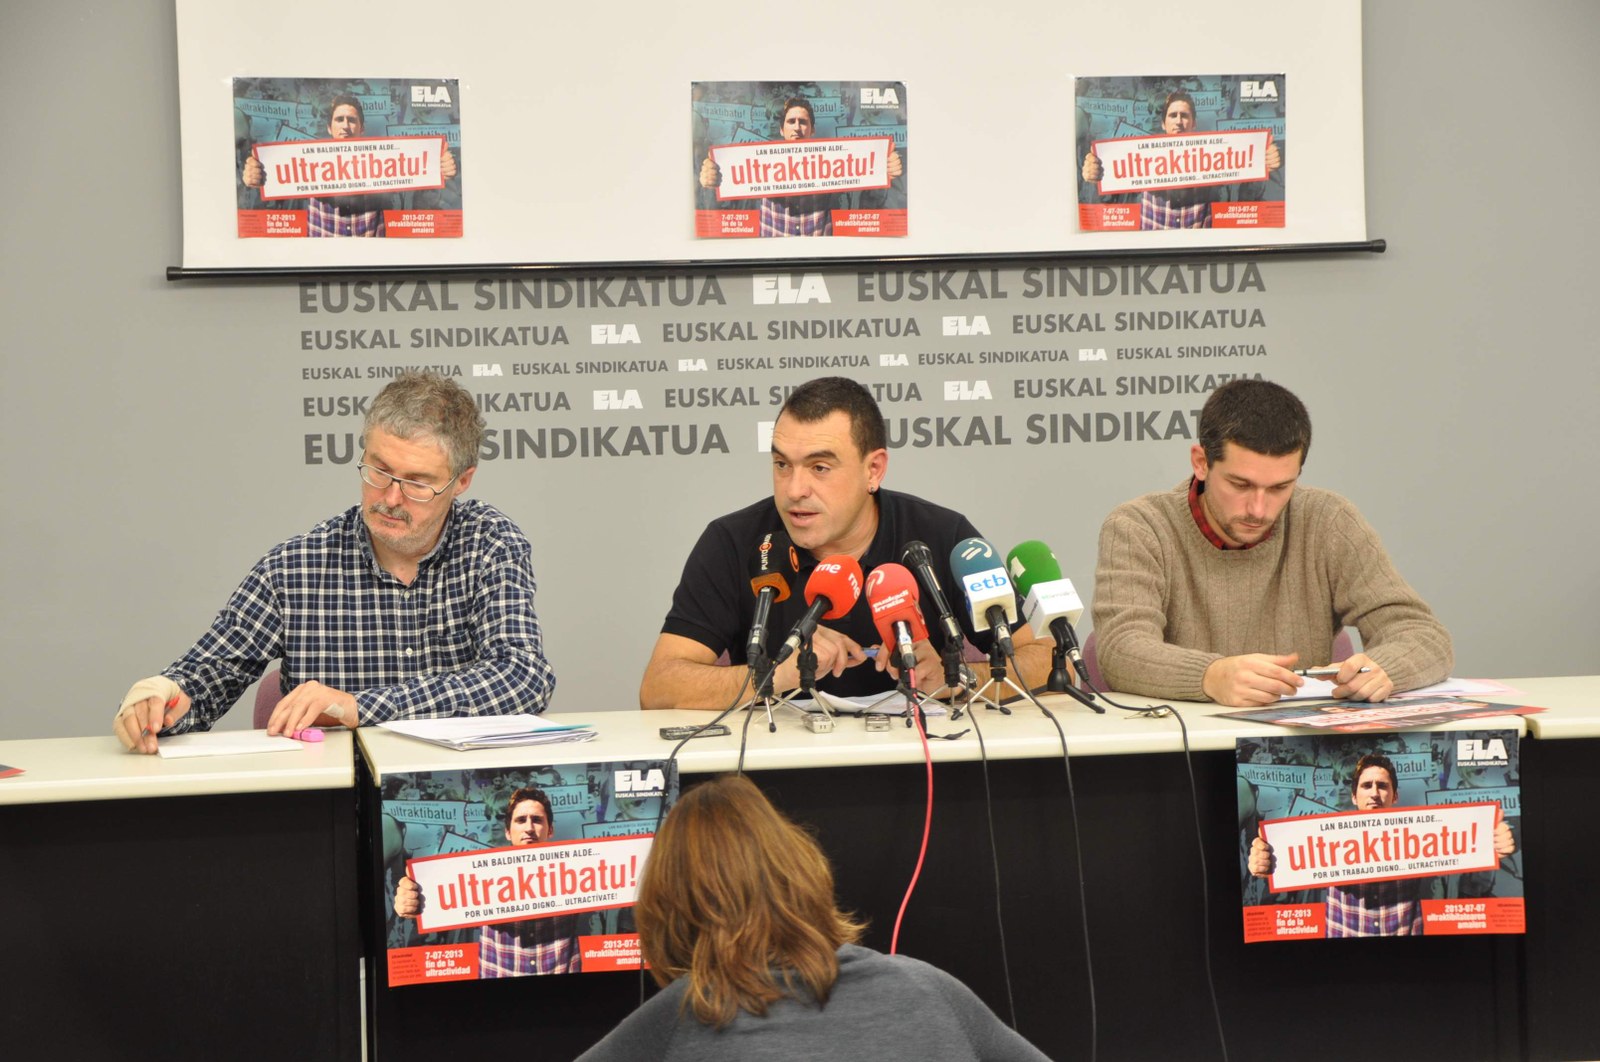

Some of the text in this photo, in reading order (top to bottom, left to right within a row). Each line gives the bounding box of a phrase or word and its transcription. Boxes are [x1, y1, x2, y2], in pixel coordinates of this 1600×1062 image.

[411, 85, 452, 103] ELA
[860, 87, 900, 105] ELA
[1240, 80, 1279, 98] ELA
[317, 145, 352, 154] BALDINTZA
[353, 144, 377, 152] DUINEN
[769, 146, 803, 155] BALDINTZA
[1151, 140, 1184, 149] BALDINTZA
[275, 150, 428, 185] ultraktibatu!
[730, 151, 876, 185] ultraktibatu!
[1112, 144, 1254, 179] ultraktibatu!
[321, 183, 347, 191] TRABAJO
[772, 183, 797, 191] TRABAJO
[299, 262, 1267, 314] EUSKAL SINDIKATUA ELA EUSKAL SINDIKATUA
[301, 308, 1267, 350] EUSKAL SINDIKATUA ELA EUSKAL SINDIKATUA ELA EUSKAL SINDIKATUA
[302, 366, 362, 380] EUSKAL
[472, 363, 503, 377] ELA
[512, 362, 571, 376] EUSKAL
[575, 359, 669, 375] SINDIKATUA
[678, 358, 708, 372] ELA
[716, 356, 774, 371] EUSKAL
[778, 354, 870, 369] SINDIKATUA
[879, 353, 910, 367] ELA
[918, 351, 974, 366] EUSKAL
[979, 349, 1070, 365] SINDIKATUA
[1078, 348, 1108, 362] ELA
[1116, 346, 1173, 360] EUSKAL
[1177, 344, 1267, 359] SINDIKATUA
[303, 396, 369, 417] EUSK
[592, 389, 643, 410] ELA
[665, 386, 760, 408] EUSKAL
[943, 380, 993, 401] ELA
[1014, 377, 1107, 398] EUSKAL
[478, 423, 730, 461] SINDIKATUA
[885, 415, 1012, 449] USKAL
[970, 574, 1007, 592] etb
[1457, 738, 1509, 761] ELA
[614, 769, 666, 792] ELA
[1245, 768, 1306, 784] ultraktibatu!
[390, 806, 457, 820] ultraktibatu!
[1320, 821, 1335, 831] LAN
[1337, 818, 1381, 830] BALDINTZA
[1384, 815, 1414, 826] DUINEN
[1287, 822, 1478, 871] ultraktibatu!
[472, 860, 489, 869] LAN
[491, 854, 537, 867] BALDINTZA
[539, 850, 570, 861] DUINEN
[1312, 871, 1328, 879] POR
[1330, 869, 1340, 878] UN
[1342, 866, 1374, 876] TRABAJO
[437, 855, 637, 911] ultraktibatu!
[465, 910, 481, 919] POR
[483, 908, 494, 916] UN
[496, 903, 530, 914] TRABAJO
[1275, 908, 1312, 919] 7-07-2013
[1444, 903, 1486, 913] 2013-07-07
[1276, 917, 1304, 927] fin de la
[1276, 925, 1318, 936] ultractividad
[425, 949, 464, 960] 7-07-2013
[425, 958, 455, 969] fin de la
[425, 966, 471, 977] ultractividad
